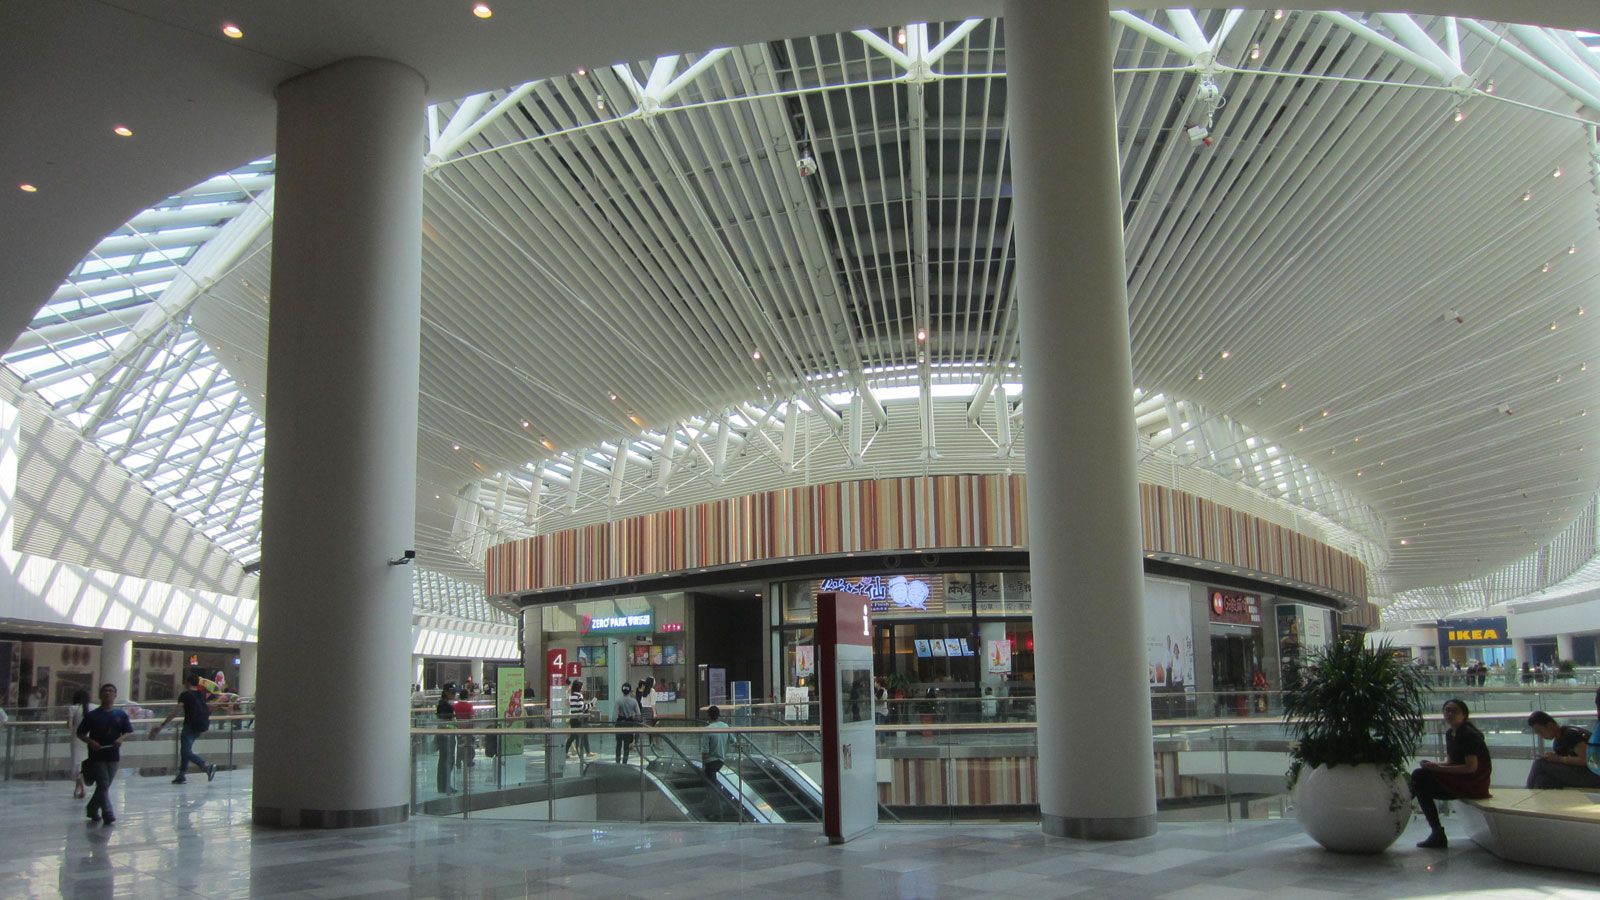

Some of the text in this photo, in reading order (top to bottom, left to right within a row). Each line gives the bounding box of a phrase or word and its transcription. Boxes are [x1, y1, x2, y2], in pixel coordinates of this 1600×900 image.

[591, 617, 609, 629] ZERO
[610, 616, 628, 628] PARK
[863, 604, 870, 636] i
[1448, 629, 1498, 641] IKEA
[553, 653, 564, 669] 4
